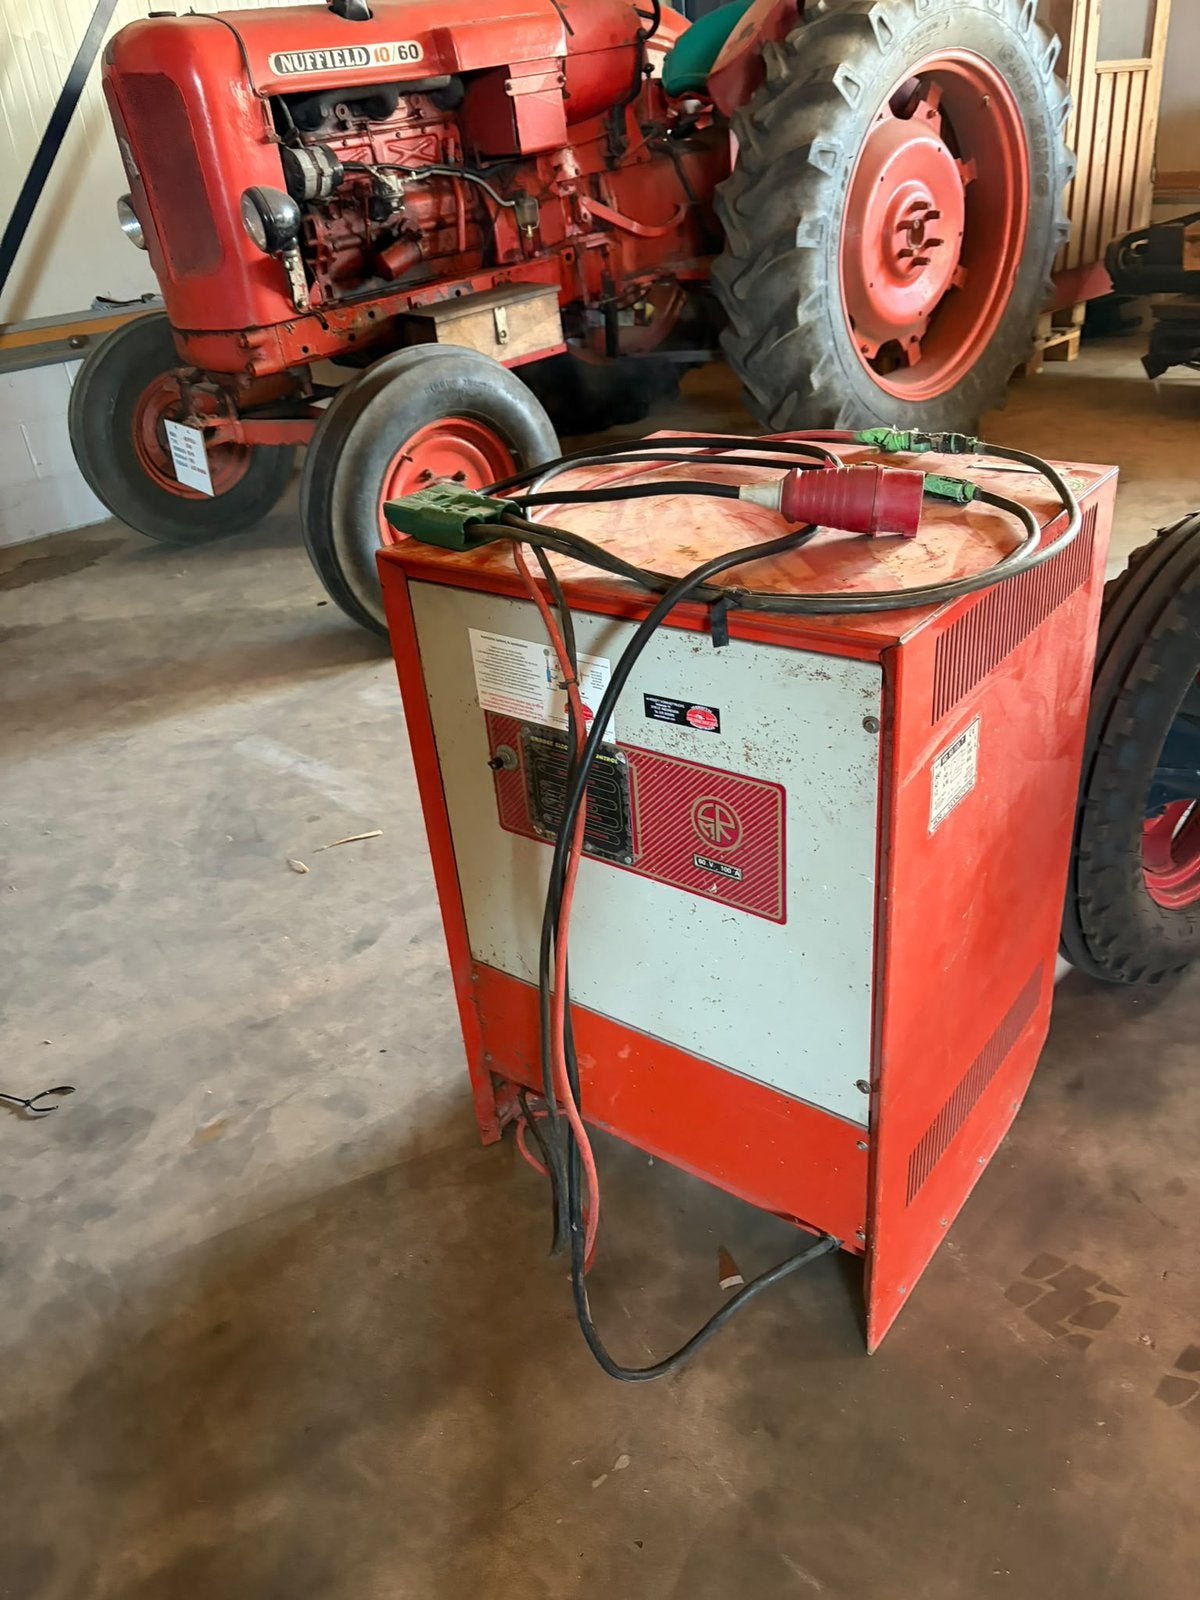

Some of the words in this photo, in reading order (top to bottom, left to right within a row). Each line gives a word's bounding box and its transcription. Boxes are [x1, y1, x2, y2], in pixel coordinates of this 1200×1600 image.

[278, 48, 368, 73] NUFFIELD
[374, 44, 420, 62] 10/60
[720, 865, 732, 874] 100
